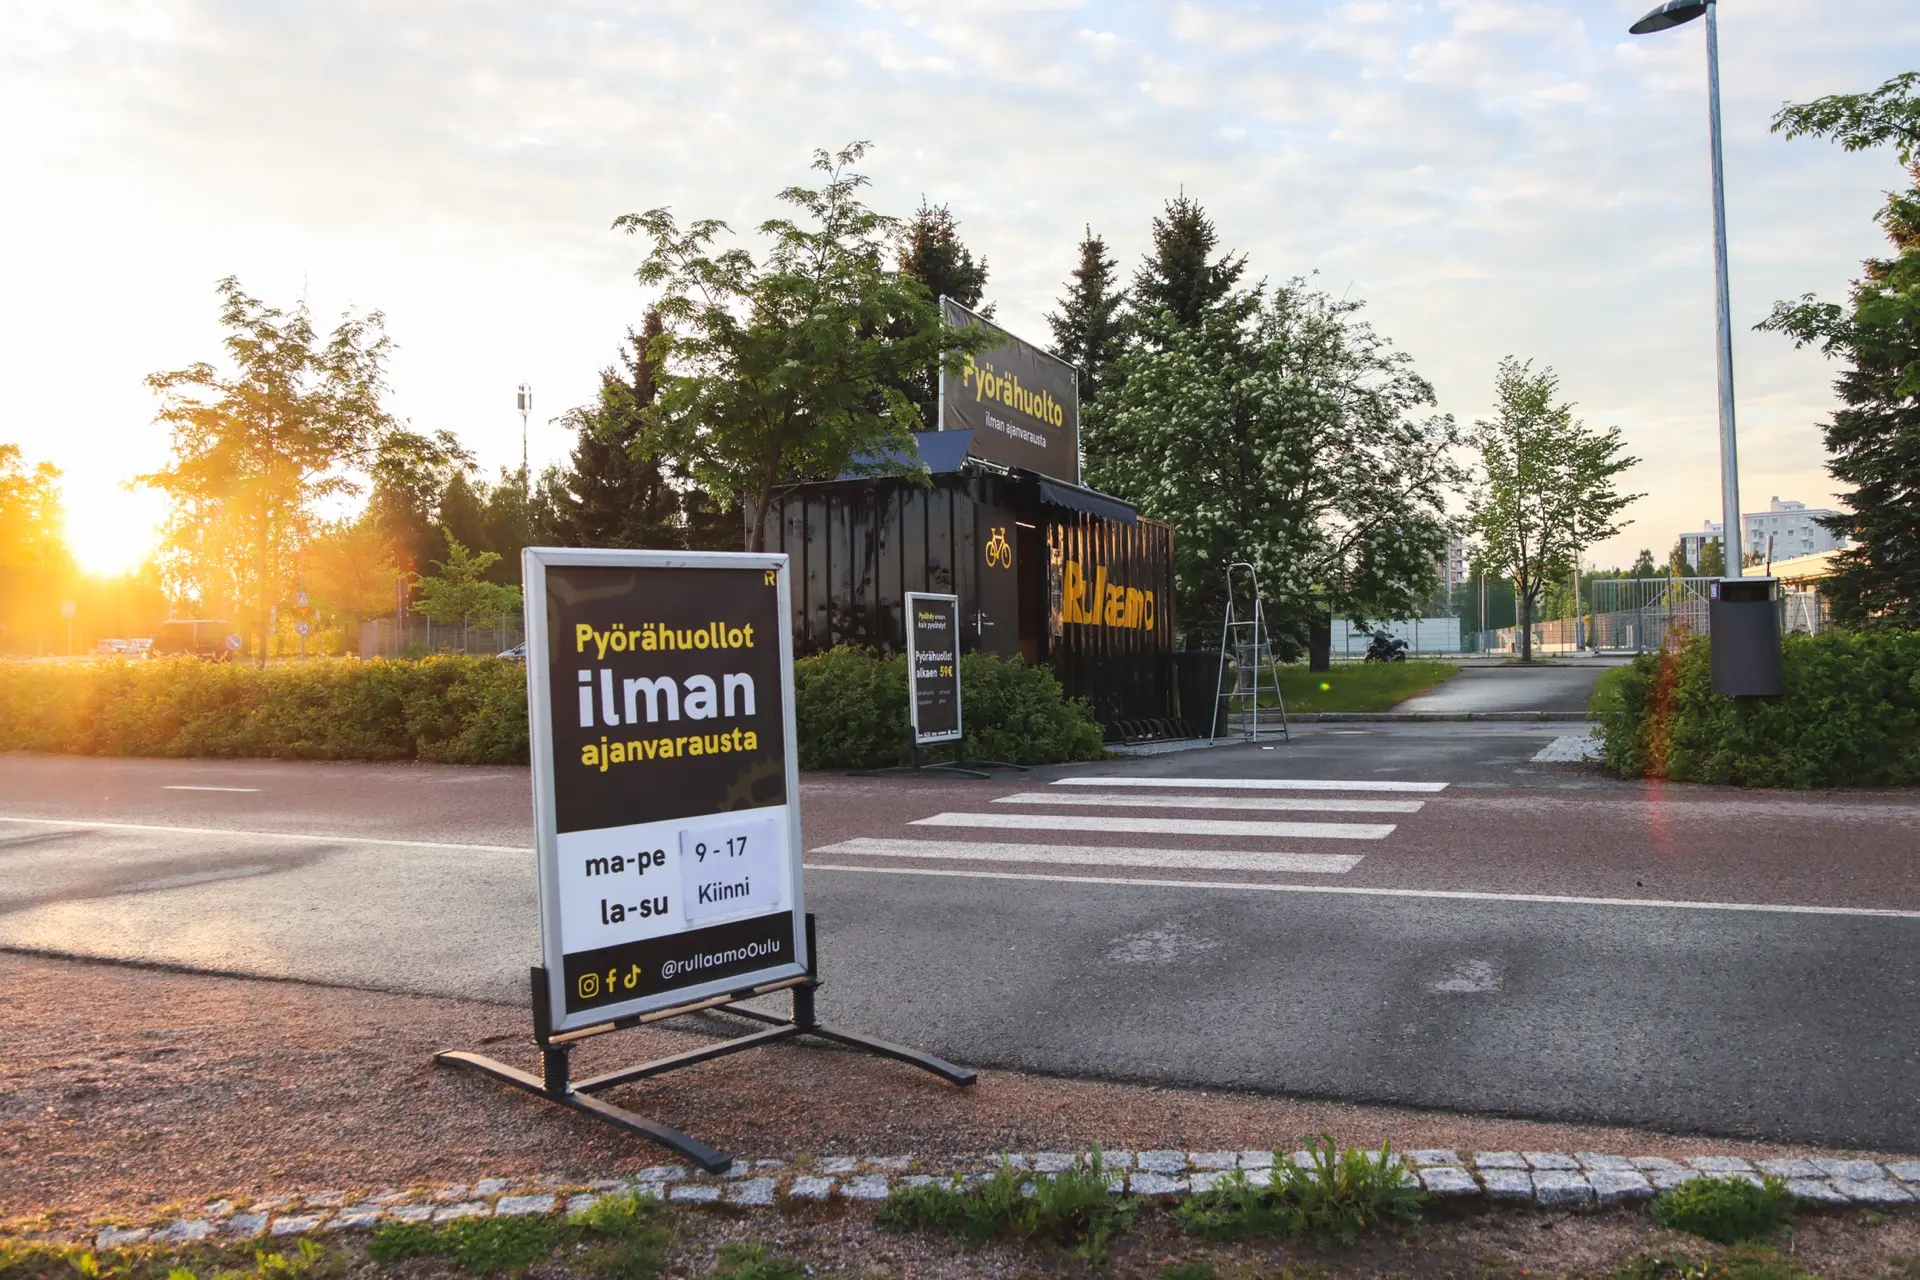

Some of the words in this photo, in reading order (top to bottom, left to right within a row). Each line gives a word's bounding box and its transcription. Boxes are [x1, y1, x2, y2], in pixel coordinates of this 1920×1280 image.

[963, 352, 1063, 428] Pyörähuolto
[985, 410, 1005, 432] ilman
[1005, 421, 1047, 448] ajanvarausta
[764, 570, 776, 586] R
[576, 622, 755, 660] Pyörähuollot
[915, 650, 953, 664] Pyörähuollot
[916, 666, 938, 678] alkaen
[939, 665, 953, 678] 59€
[577, 668, 756, 728] ilman
[581, 727, 757, 773] ajanvarausta
[585, 848, 666, 877] ma-pe
[695, 842, 707, 863] 9
[726, 836, 748, 858] 17
[698, 876, 751, 905] Kiinni
[600, 895, 669, 925] la-su
[661, 938, 780, 980] @rullaamoOulu
